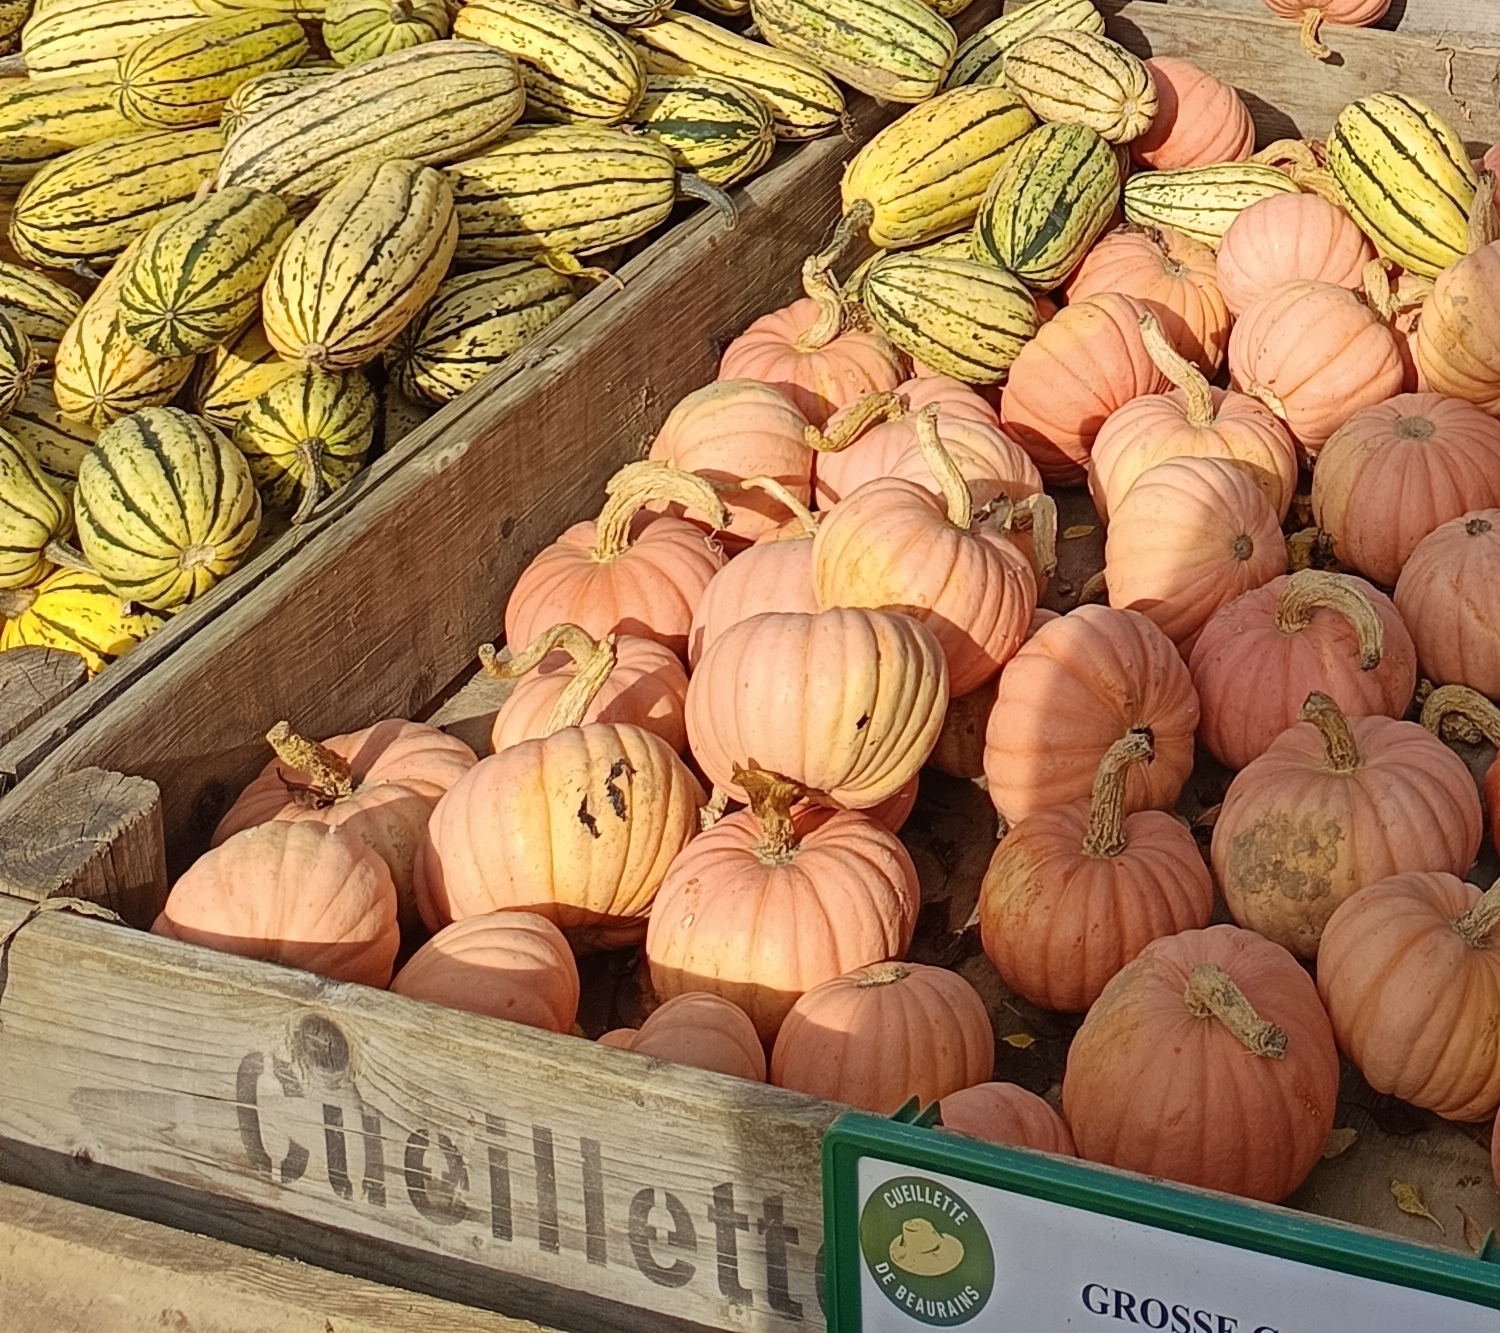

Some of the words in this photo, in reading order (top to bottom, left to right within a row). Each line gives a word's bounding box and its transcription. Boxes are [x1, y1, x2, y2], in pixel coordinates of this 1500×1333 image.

[235, 1051, 826, 1322] Cueillett
[883, 1184, 969, 1226] CUEILLETTE
[875, 1262, 896, 1285] DE
[895, 1285, 980, 1319] BEAURAINS
[1081, 1283, 1239, 1333] GROSSE
